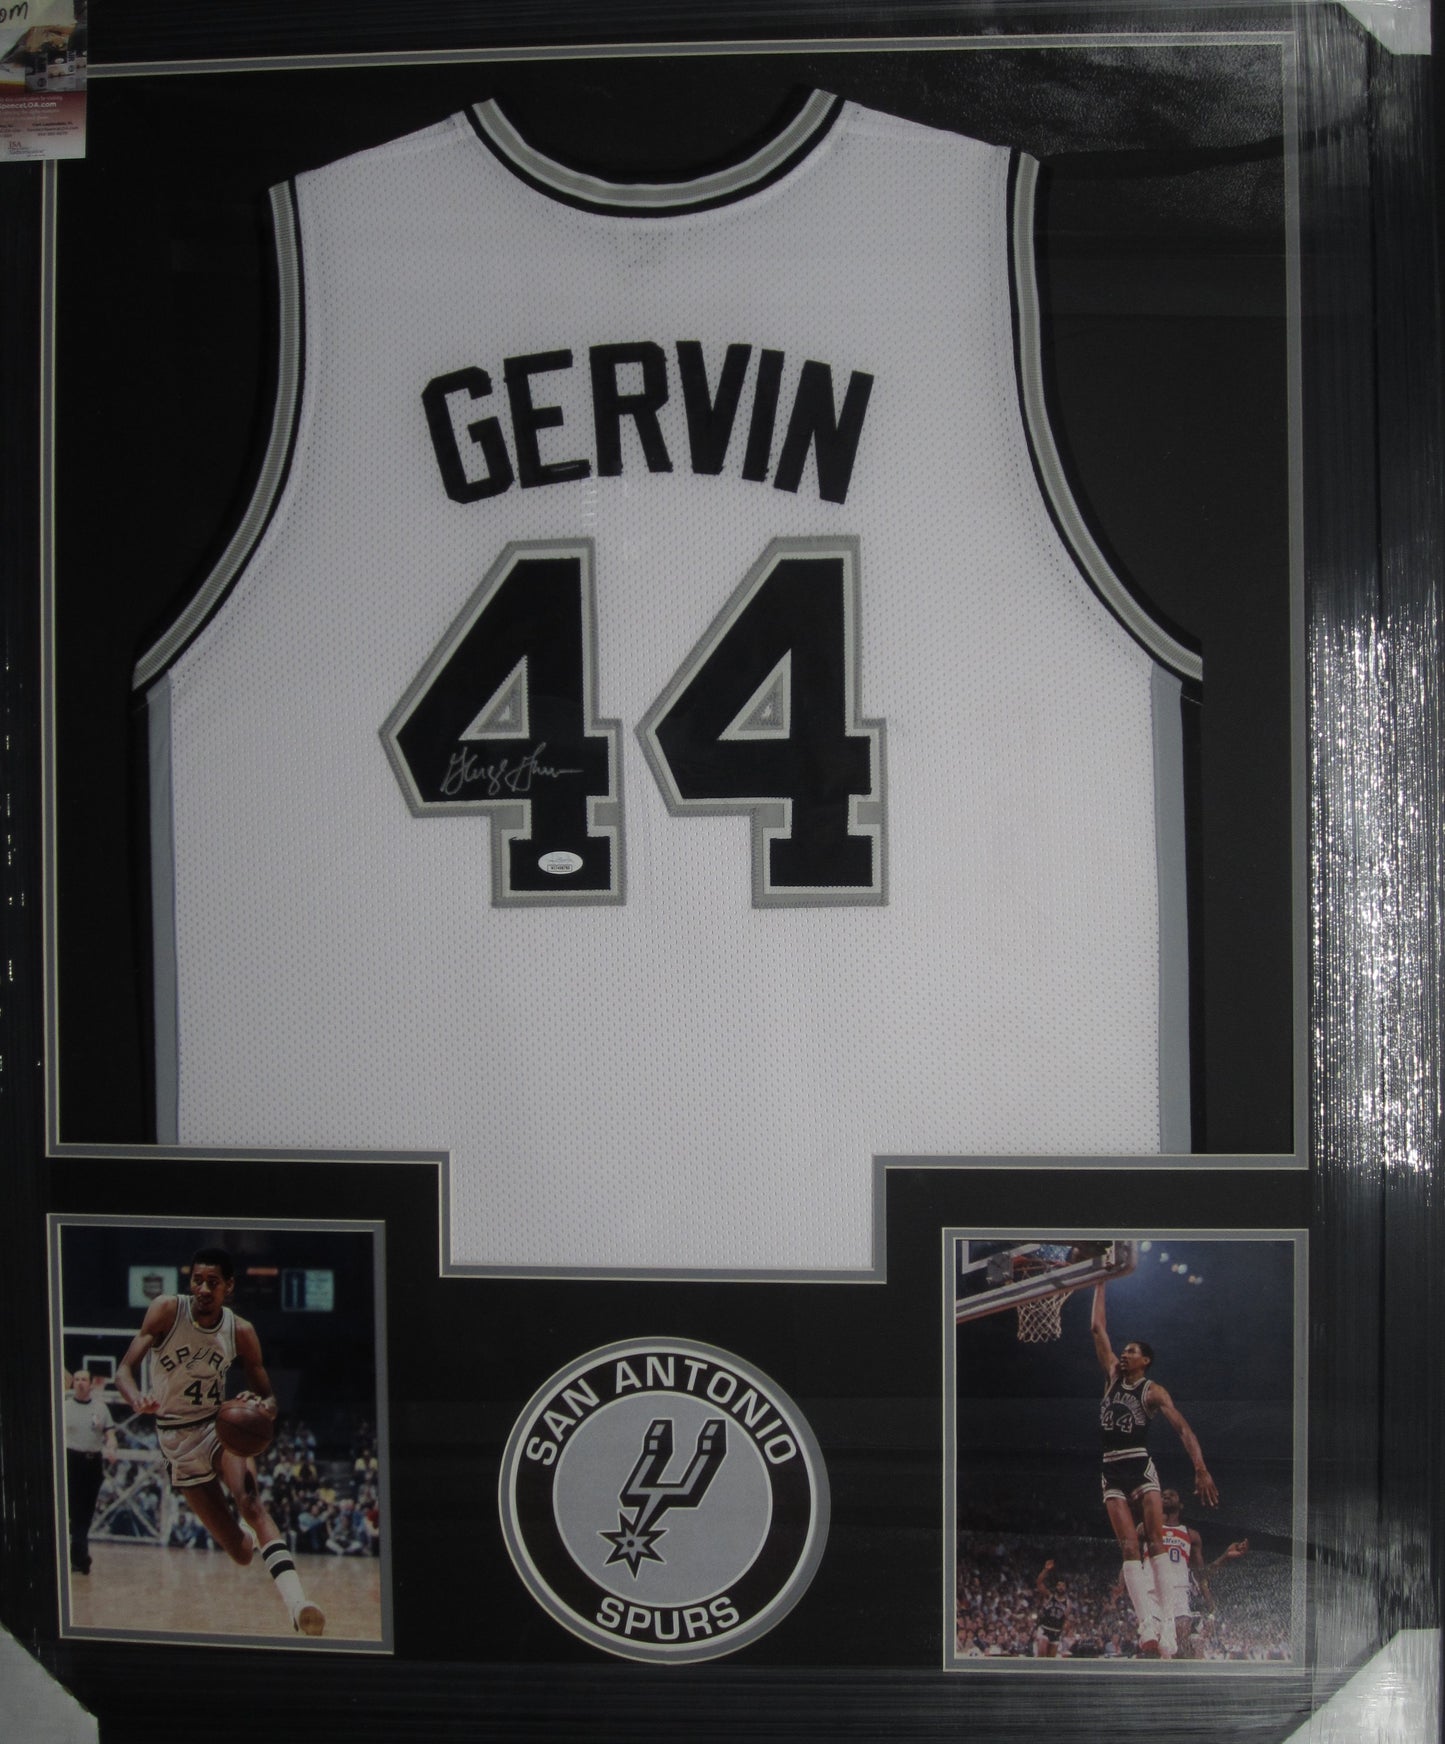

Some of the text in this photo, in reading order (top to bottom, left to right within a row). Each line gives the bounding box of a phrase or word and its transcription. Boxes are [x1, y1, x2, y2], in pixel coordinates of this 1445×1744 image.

[421, 340, 874, 504] GERVIN
[378, 535, 889, 909] 44
[184, 1379, 222, 1406] 44
[526, 1356, 797, 1466] SAN ANTONIO
[1101, 1410, 1133, 1433] 44
[596, 1597, 740, 1640] SPURS
